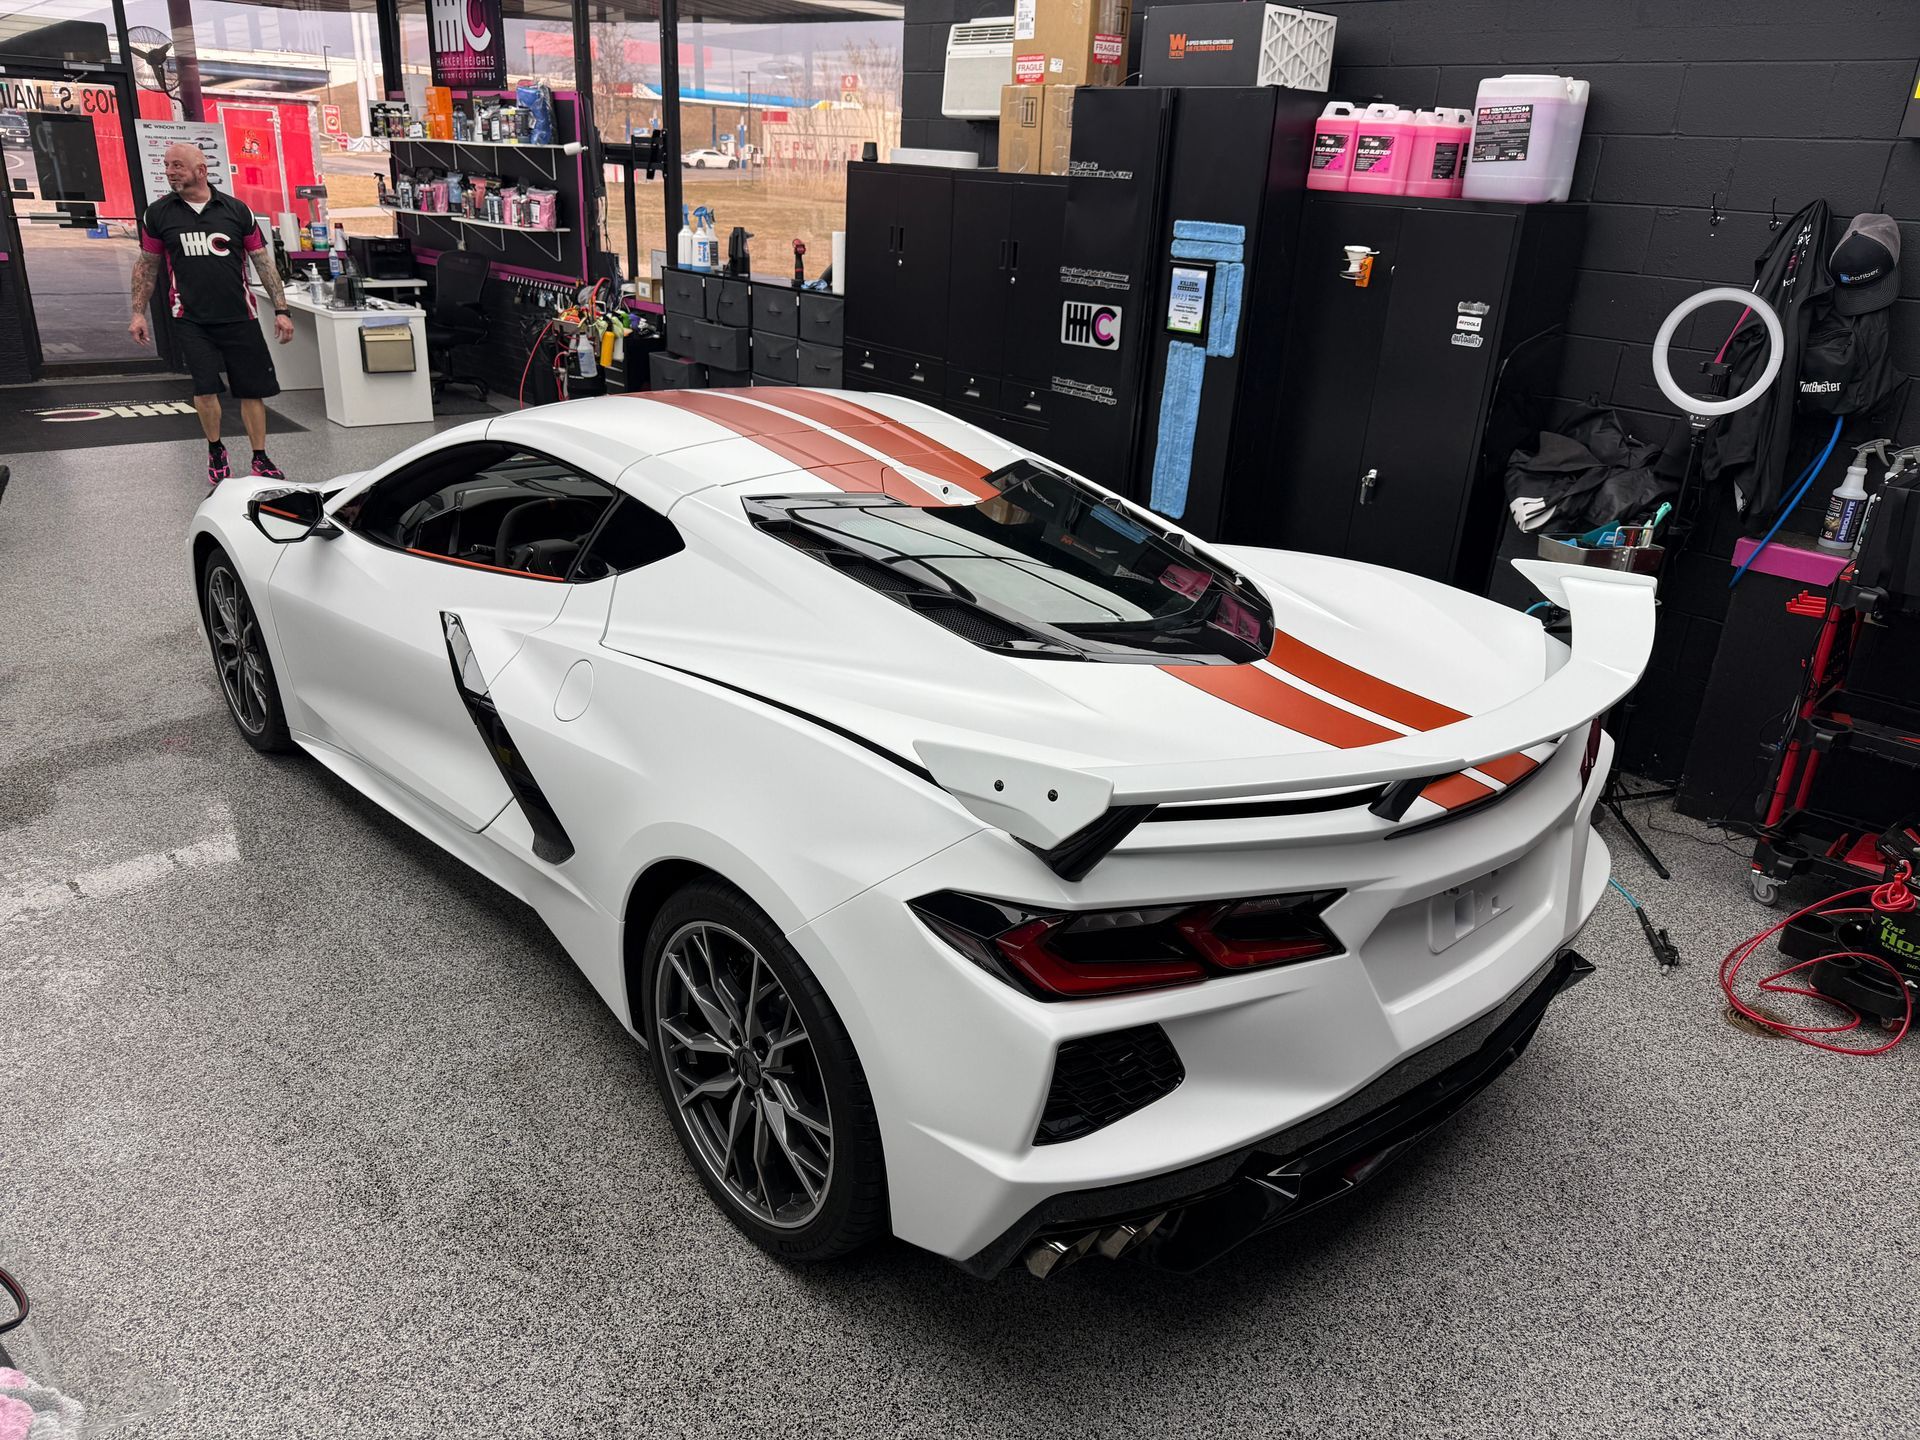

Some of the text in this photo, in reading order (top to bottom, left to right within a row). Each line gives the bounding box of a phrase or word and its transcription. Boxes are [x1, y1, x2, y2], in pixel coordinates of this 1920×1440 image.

[1095, 43, 1121, 54] FRAGILE
[437, 55, 495, 67] HARKER HEIGHTS
[1017, 63, 1043, 72] FRAGILE
[465, 71, 496, 81] coatings
[1838, 501, 1857, 541] ABSOLUTE
[1881, 915, 1906, 935] Tint
